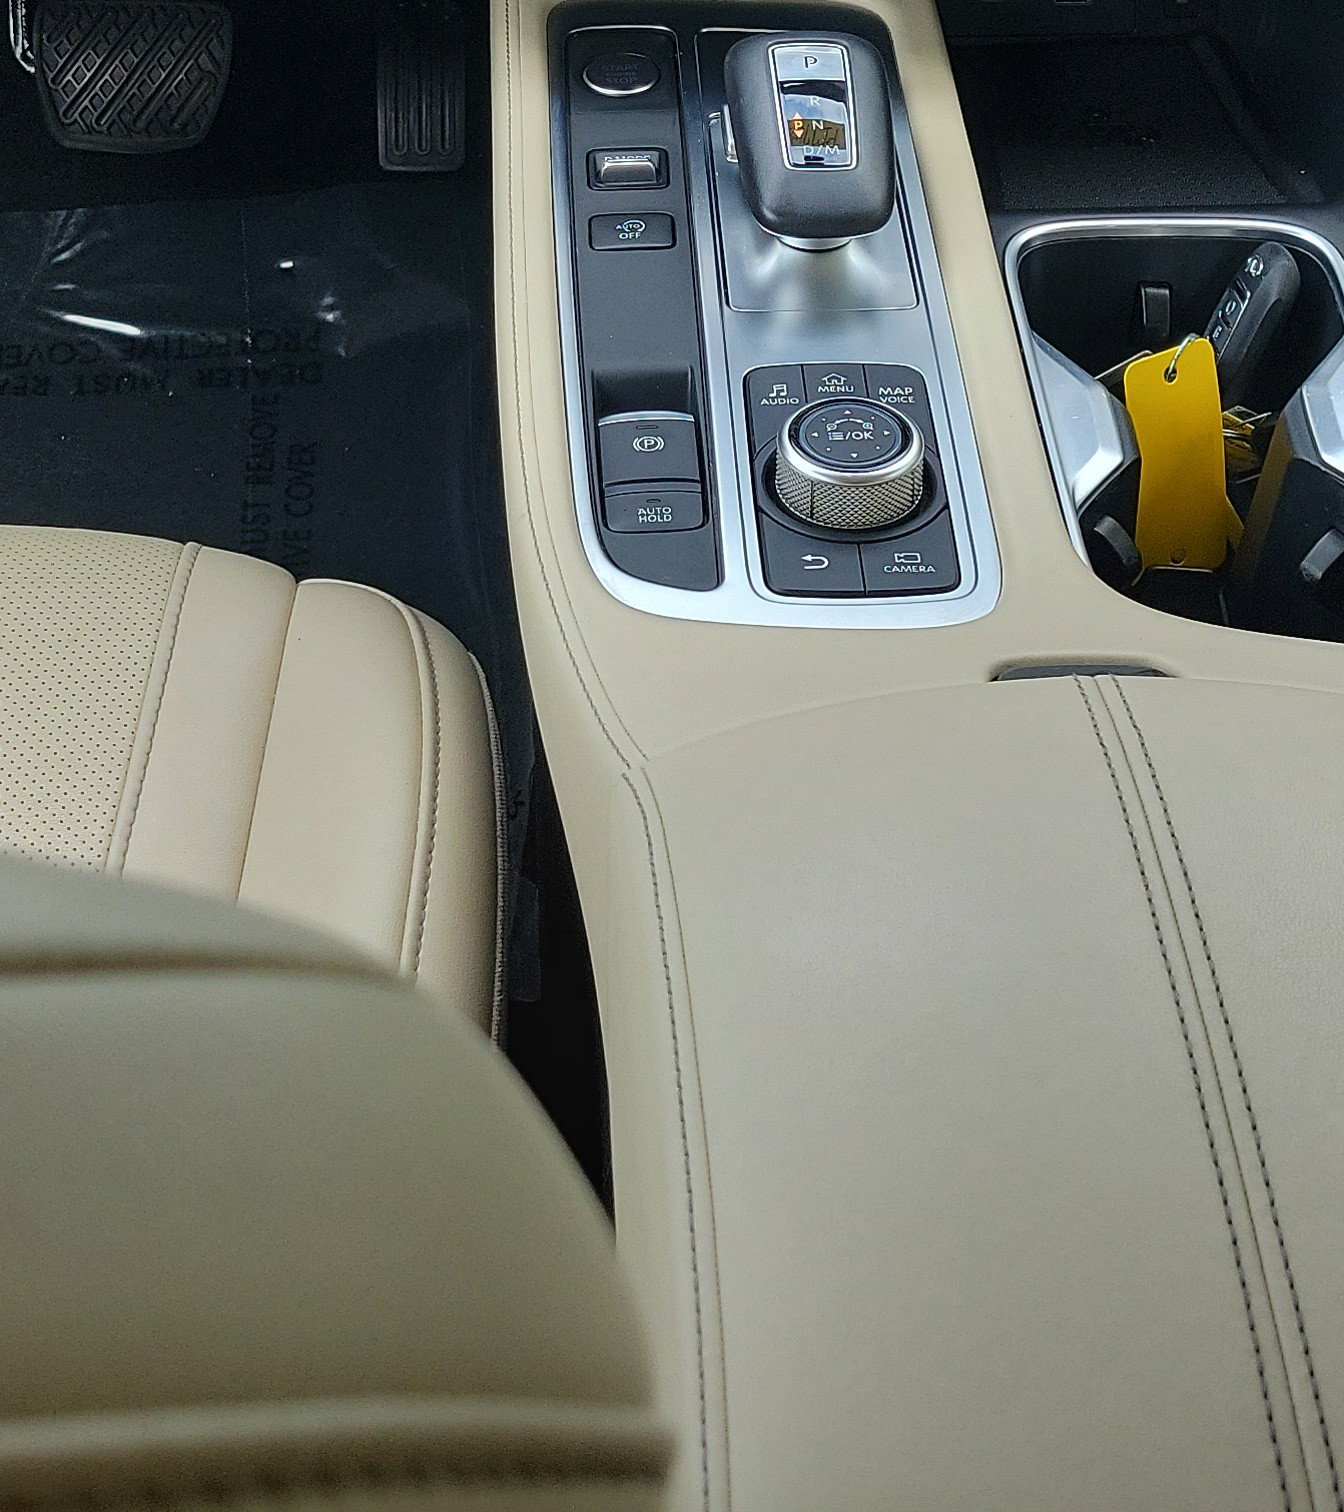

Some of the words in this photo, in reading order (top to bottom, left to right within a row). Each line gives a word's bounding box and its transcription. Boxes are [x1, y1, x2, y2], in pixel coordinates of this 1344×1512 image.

[803, 55, 818, 69] P
[809, 96, 821, 106] R
[793, 121, 803, 129] P
[812, 120, 824, 131] N
[803, 145, 841, 155] D/M
[618, 231, 641, 240] OFF
[878, 387, 914, 396] MAP
[760, 397, 799, 405] AUDIO
[879, 396, 915, 404] VOICE
[638, 506, 672, 515] AUTO
[638, 514, 673, 523] HOLD
[883, 565, 936, 573] CAMERA
